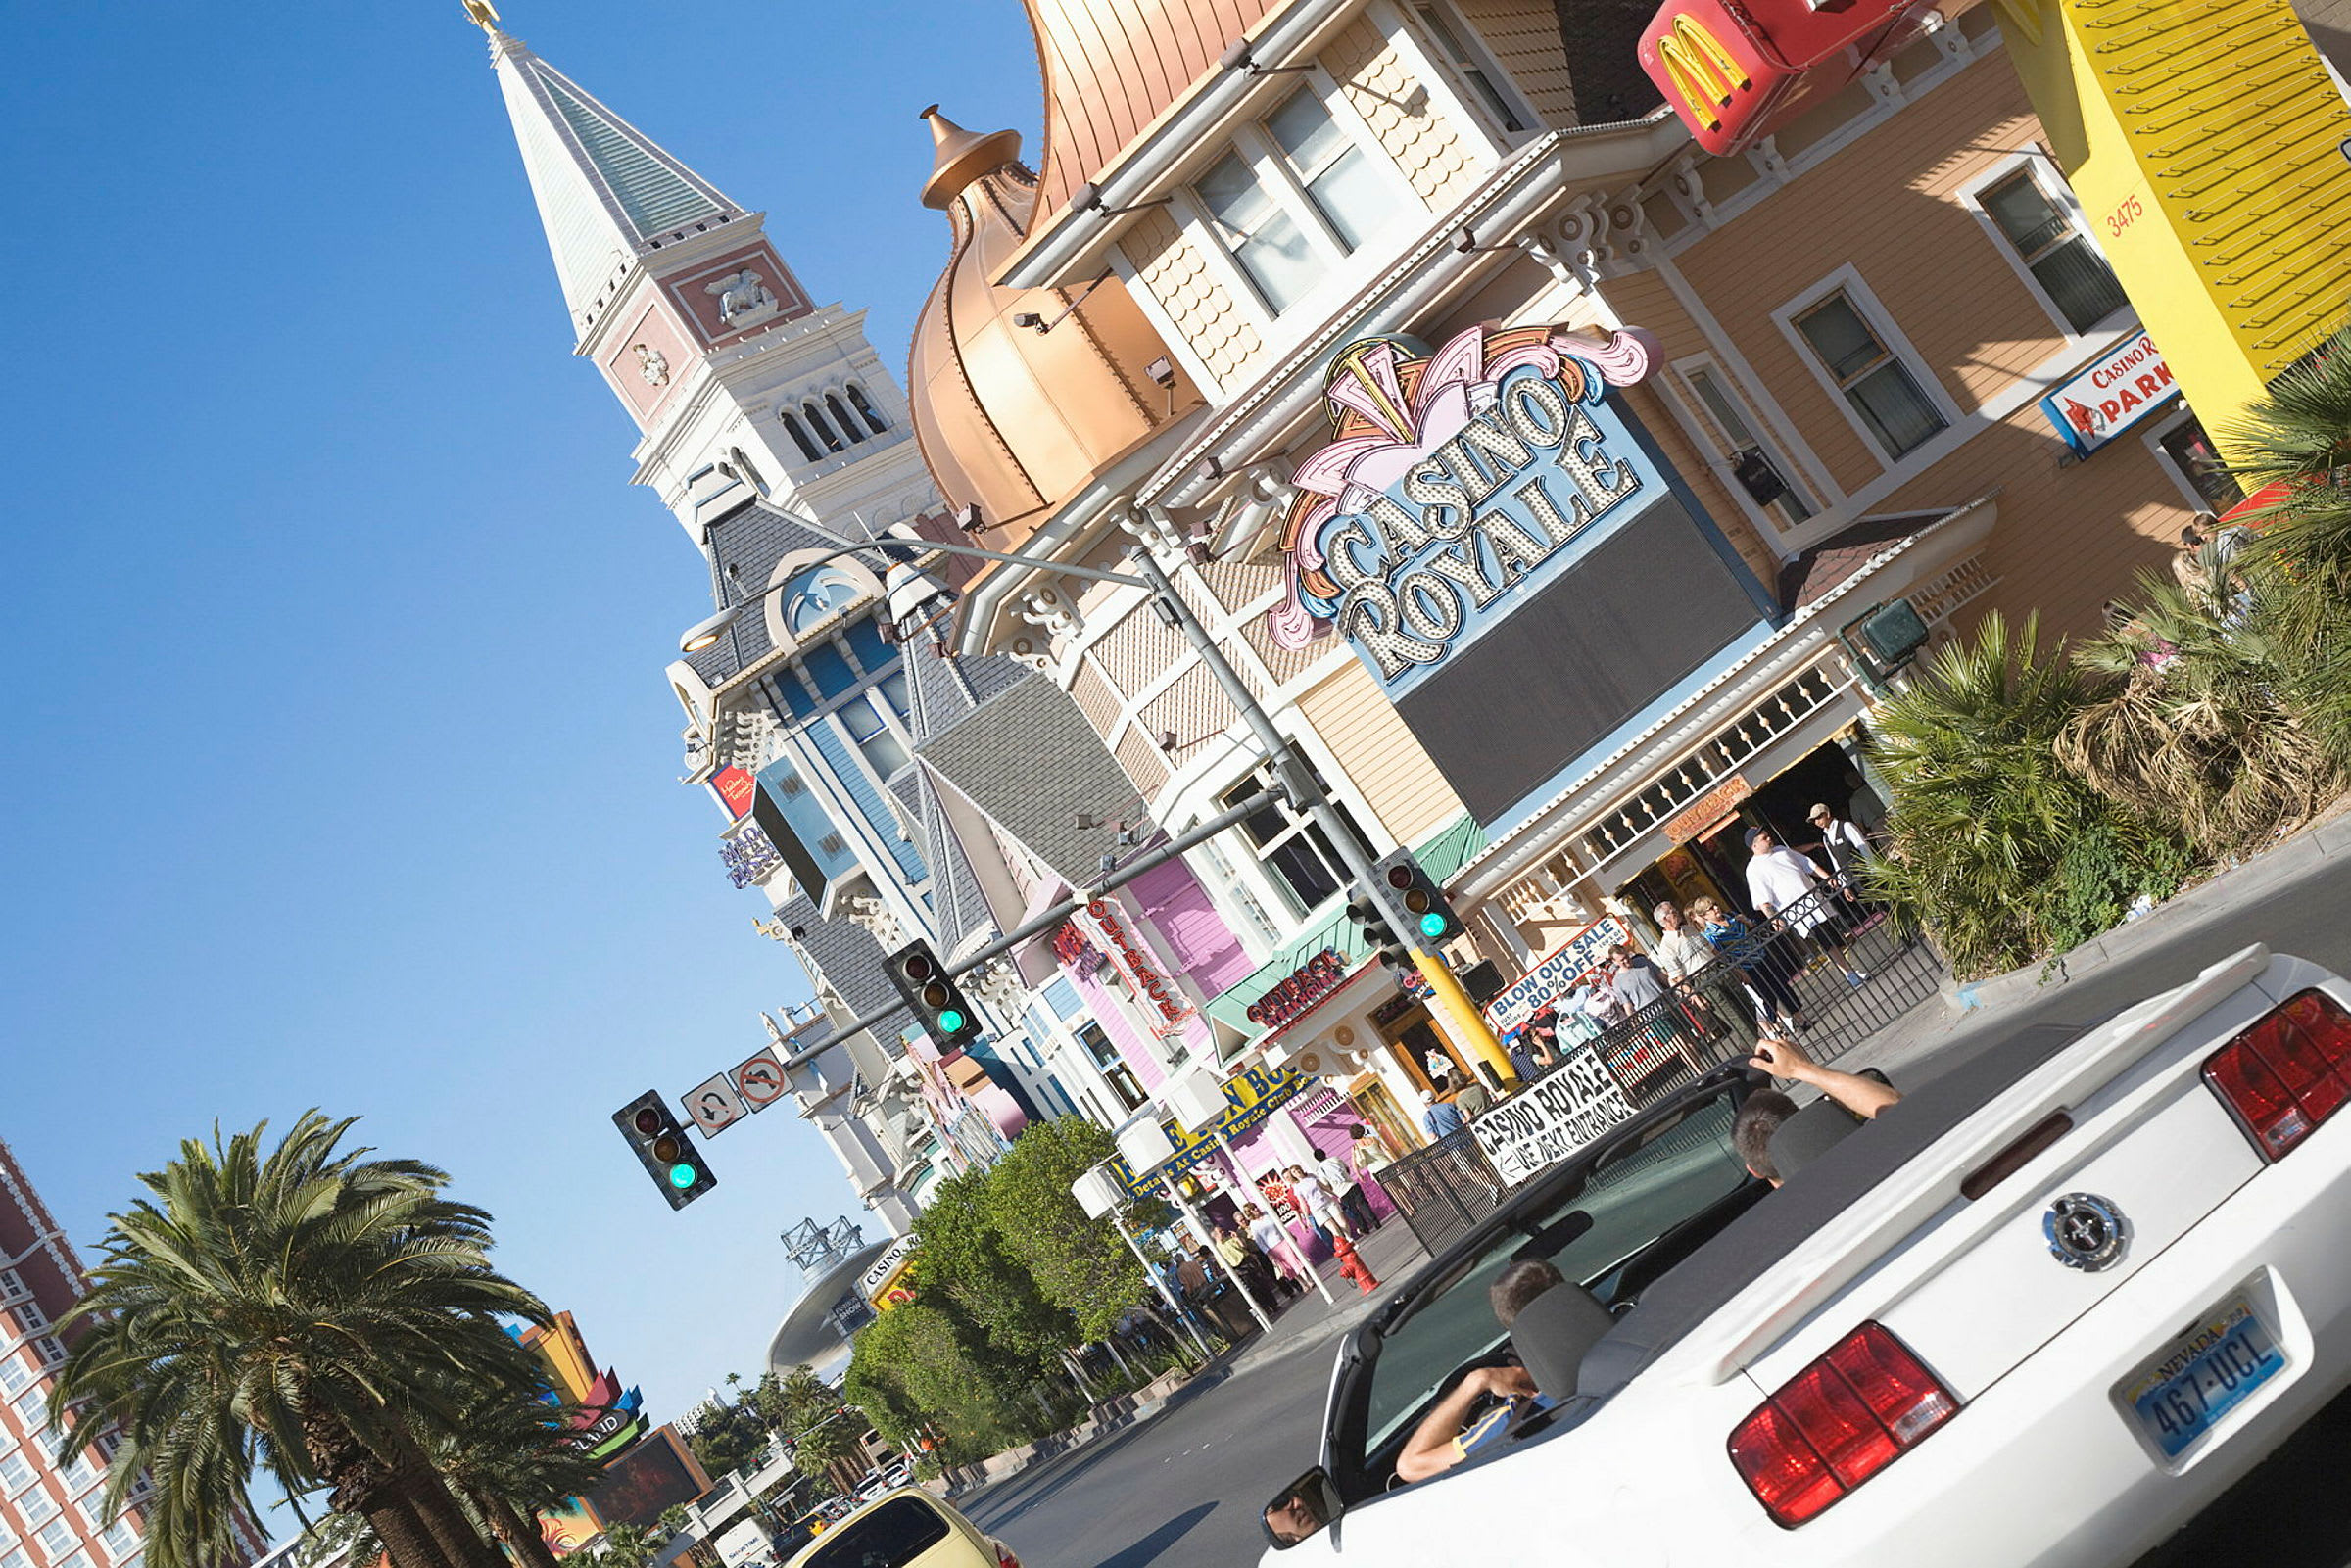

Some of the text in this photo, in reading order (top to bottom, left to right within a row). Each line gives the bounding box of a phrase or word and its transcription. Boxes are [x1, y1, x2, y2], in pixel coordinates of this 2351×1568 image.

[2107, 195, 2142, 237] 3475
[2092, 348, 2144, 389] CASINO
[1327, 377, 1569, 591] CASINO
[1337, 406, 1643, 684] ROYALE
[1087, 900, 1180, 1021] OUTBACK
[1493, 919, 1614, 1017] BLOW OUT SALE
[1176, 1156, 1191, 1172] At
[1228, 1108, 1267, 1136] Royale
[1267, 1088, 1292, 1109] Club
[1474, 1055, 1615, 1157] CASINO ROYALE
[1515, 1092, 1634, 1171] USE NEXT ENTRANCE
[866, 1248, 901, 1286] CASINO
[839, 1301, 862, 1321] SHOW
[2157, 1326, 2222, 1383] NEVADA
